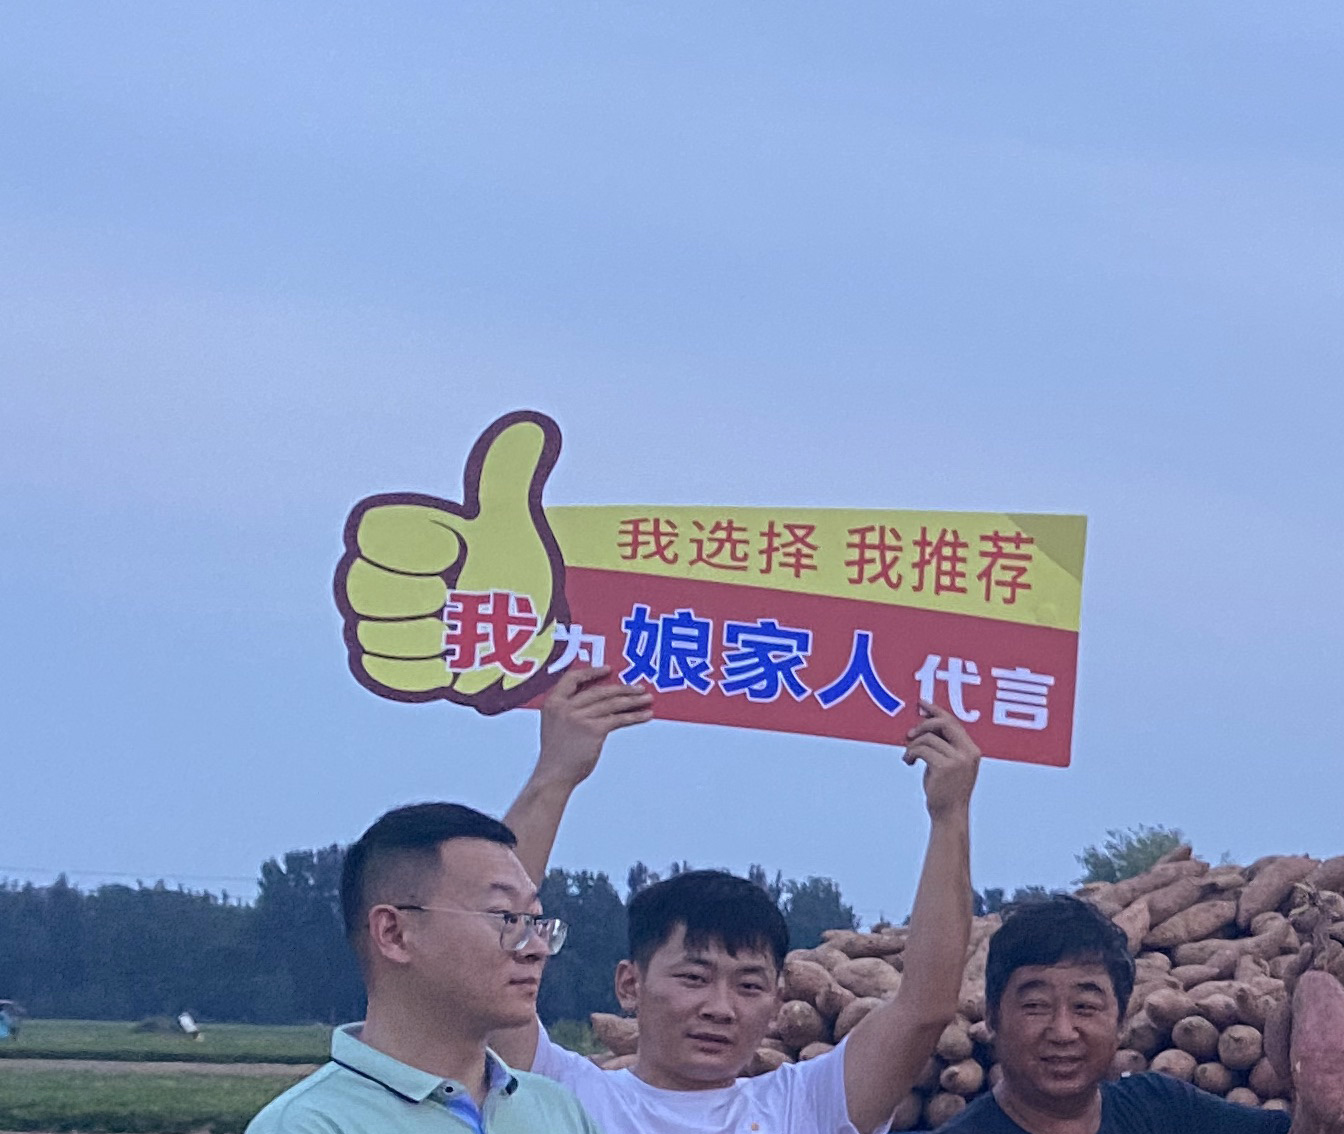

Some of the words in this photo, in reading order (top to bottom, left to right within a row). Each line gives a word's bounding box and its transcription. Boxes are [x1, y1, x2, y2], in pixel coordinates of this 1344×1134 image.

[616, 516, 819, 577] 我选择
[844, 525, 1035, 604] 我推荐
